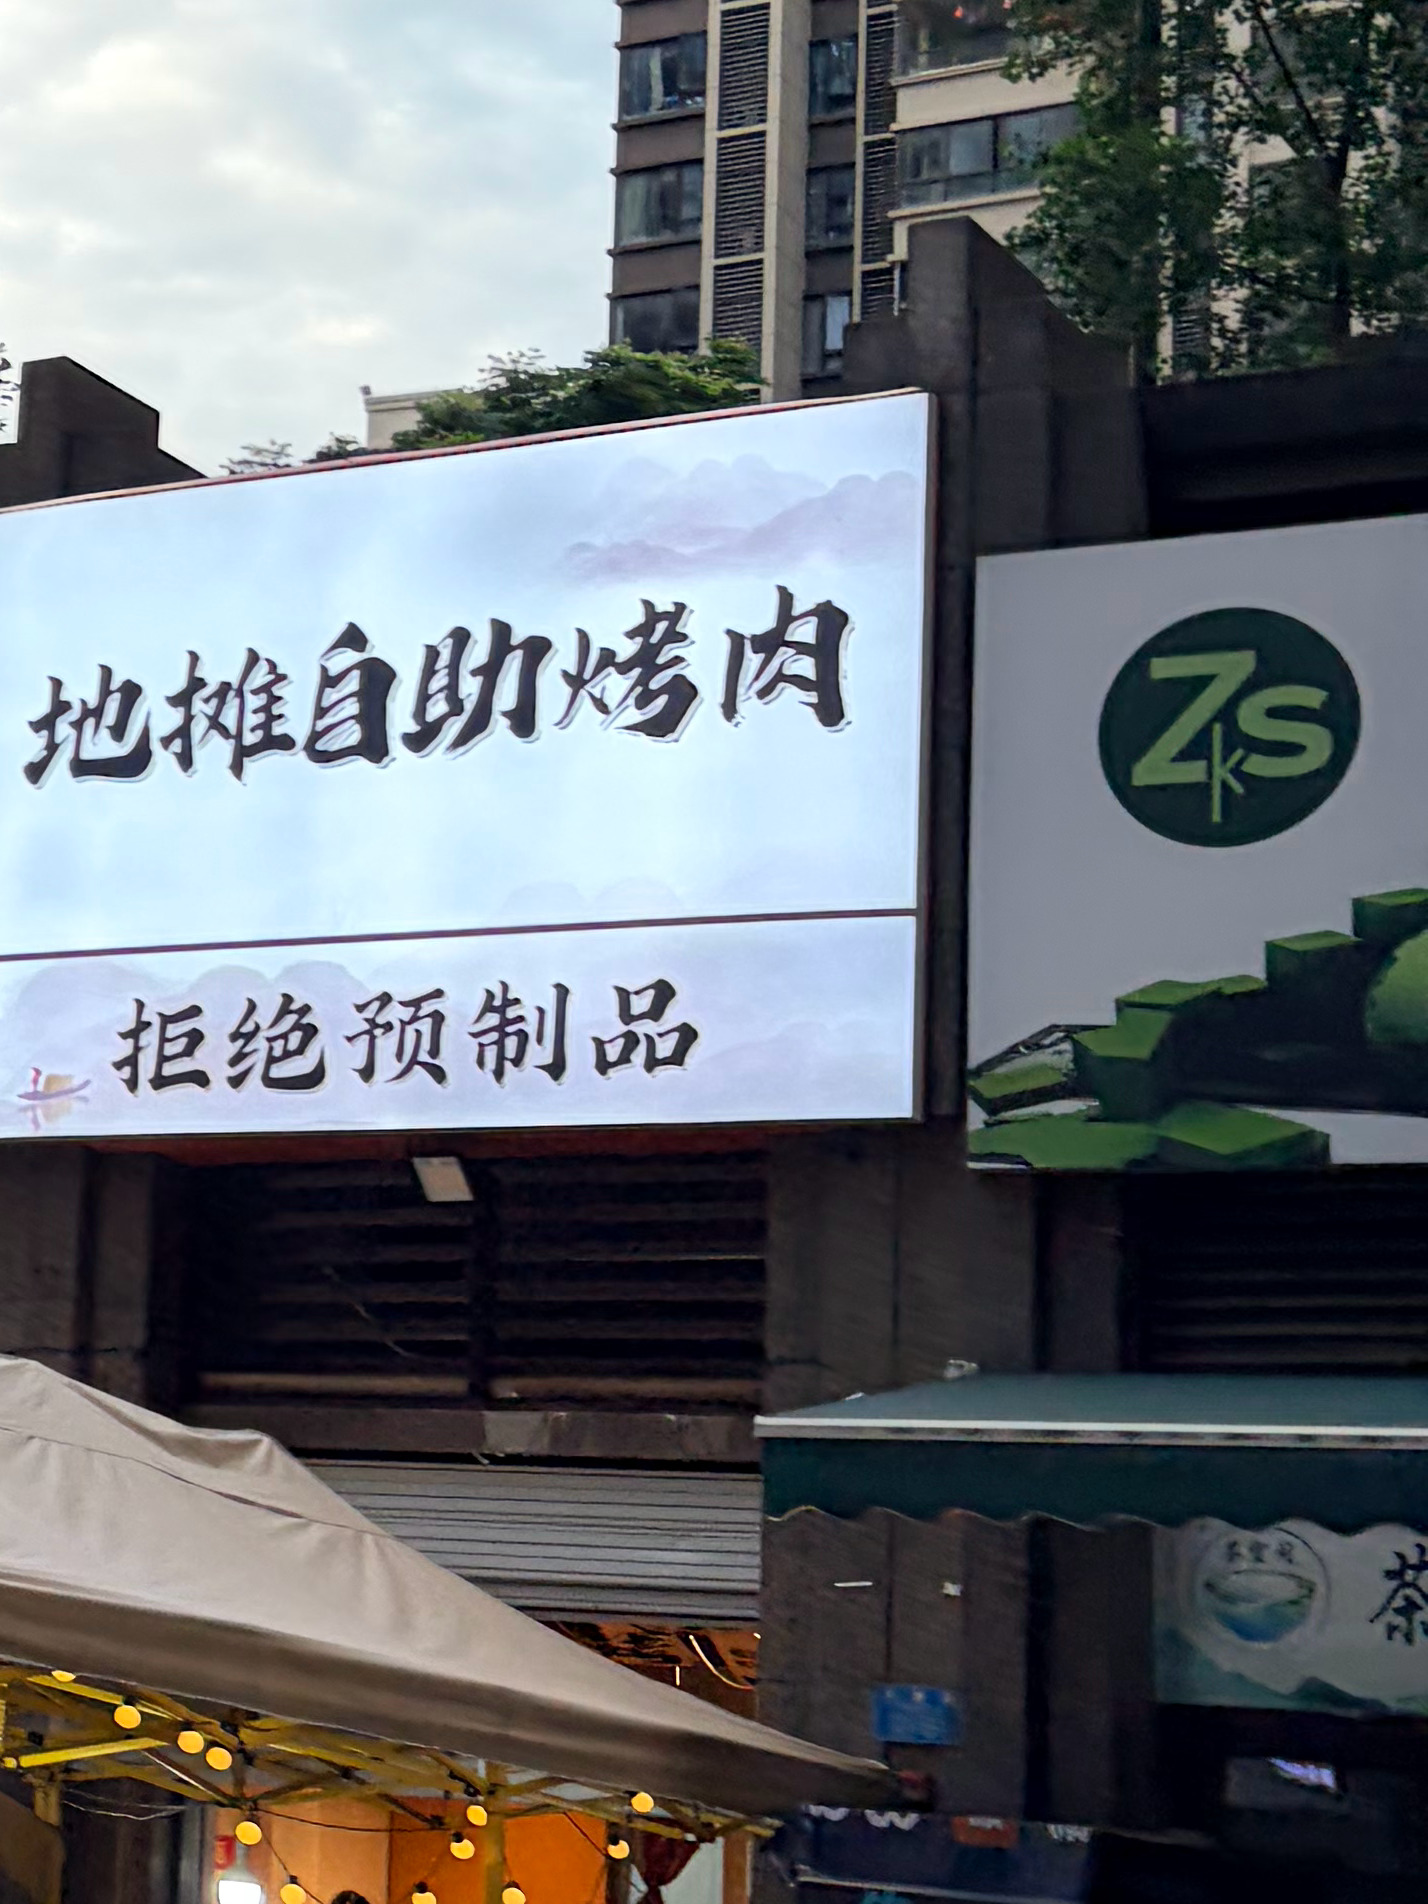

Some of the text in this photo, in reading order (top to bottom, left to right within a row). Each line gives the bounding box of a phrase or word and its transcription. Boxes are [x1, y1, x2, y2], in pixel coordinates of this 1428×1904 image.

[23, 585, 854, 788] 地摊自助烤肉
[111, 978, 701, 1093] 拒绝预制品
